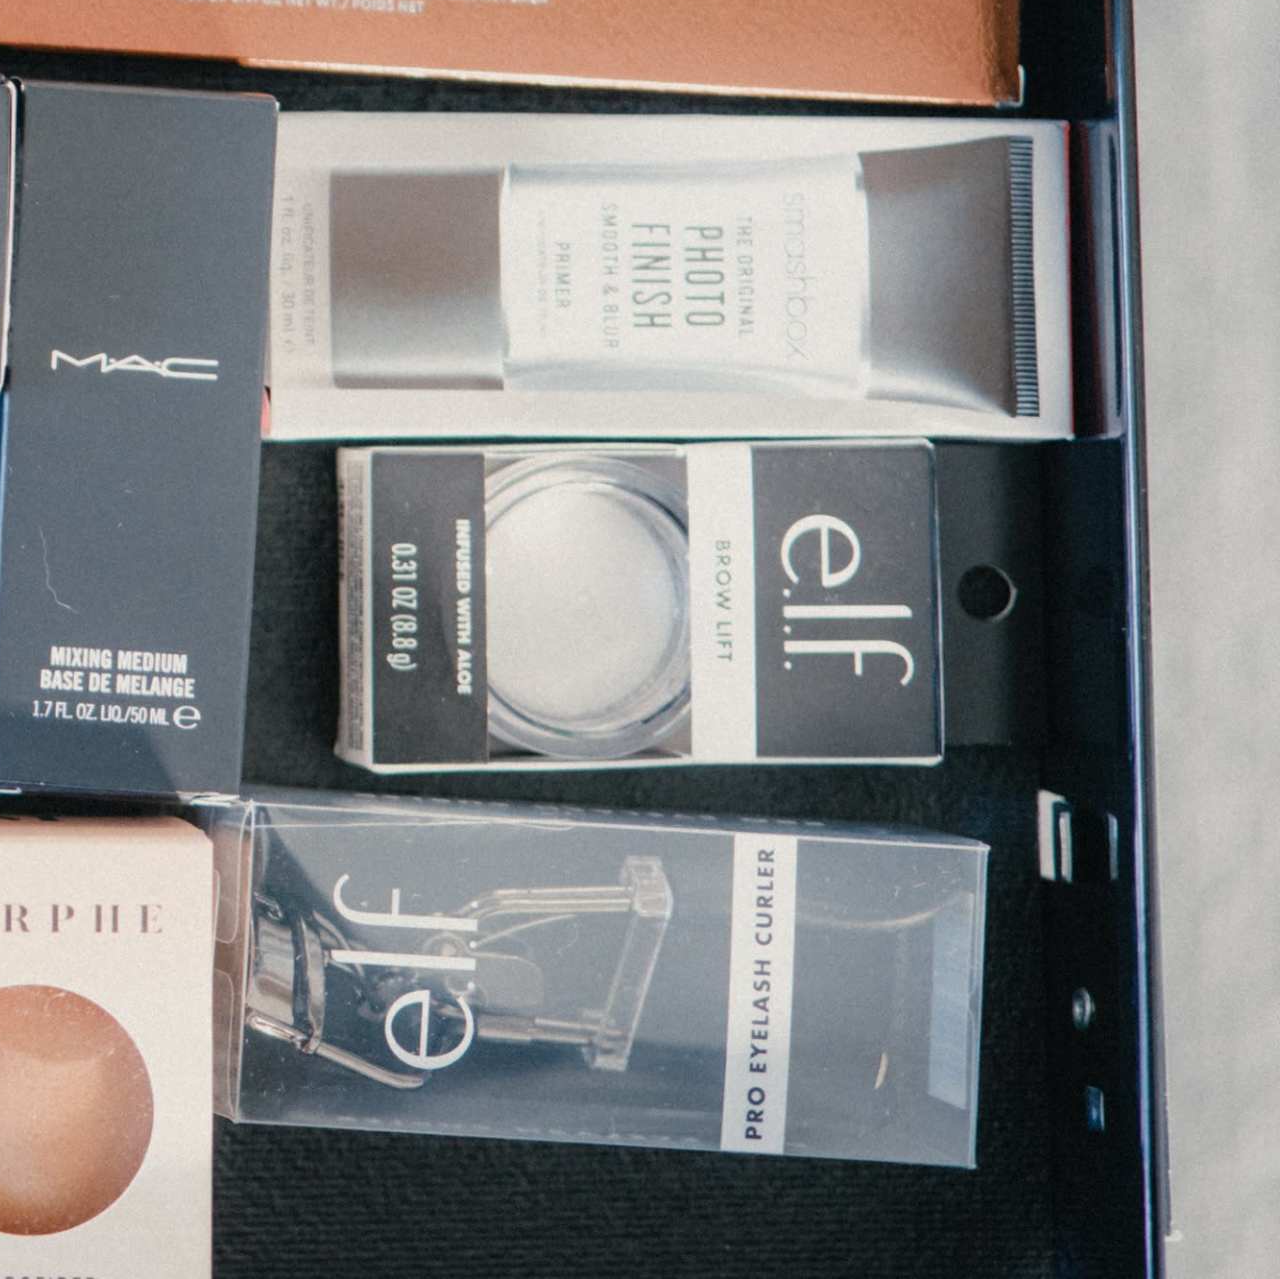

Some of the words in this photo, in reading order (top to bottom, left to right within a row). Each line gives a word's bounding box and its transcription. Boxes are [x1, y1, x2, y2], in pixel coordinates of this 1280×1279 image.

[601, 202, 619, 277] SMOOTH
[737, 216, 753, 252] THE
[555, 241, 571, 311] PRIMER
[630, 223, 673, 329] FINISH
[684, 225, 726, 328] PHOTO
[737, 254, 755, 337] ORIGINAL
[783, 192, 817, 362] smashbox
[602, 303, 620, 350] BLUR
[391, 542, 418, 581] 0.31
[455, 518, 471, 595] INFUSED
[714, 538, 732, 610] BROW
[391, 586, 418, 611] OZ
[456, 597, 472, 645] WITH
[389, 613, 419, 649] (8.8
[716, 615, 734, 664] LIFT
[39, 668, 85, 693] BASE
[87, 671, 112, 694] DE
[114, 673, 197, 699] MELANGE
[49, 645, 113, 670] MIXING
[116, 648, 189, 674] MEDIUM
[385, 651, 418, 672] g)
[456, 648, 473, 696] ALOE
[31, 699, 54, 719] 1.7
[753, 847, 776, 947] CURLER
[748, 958, 773, 1075] EYELASH
[744, 1086, 767, 1141] PRO
